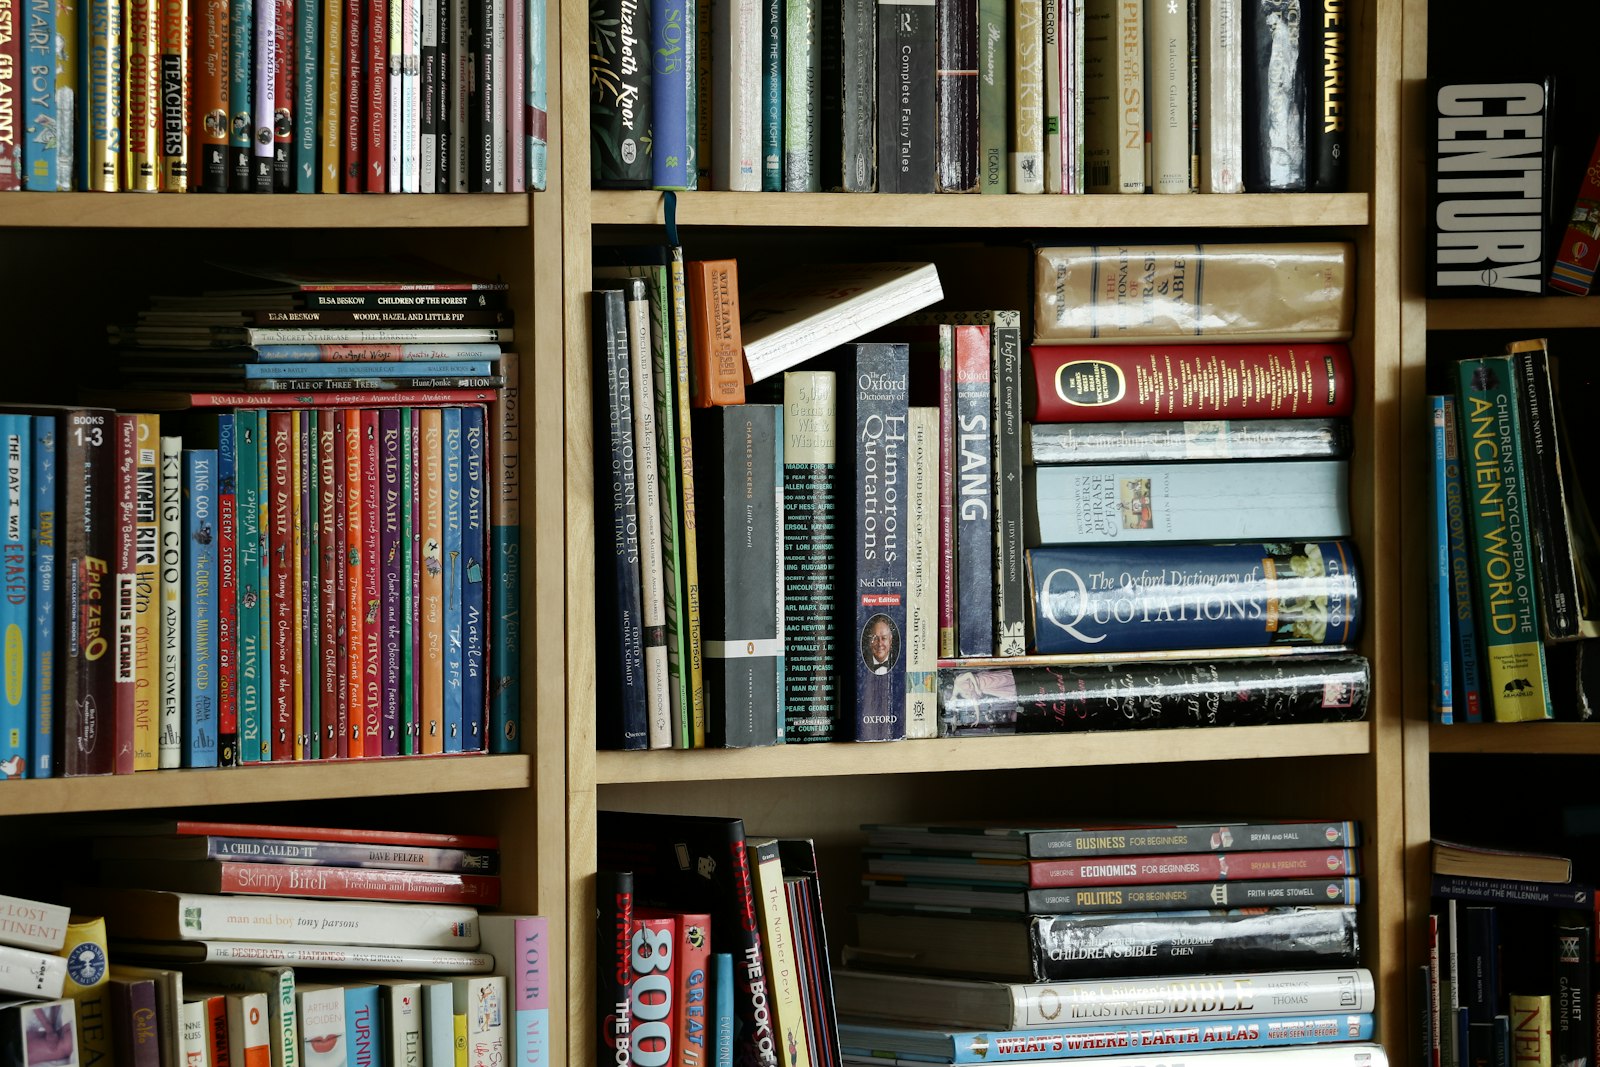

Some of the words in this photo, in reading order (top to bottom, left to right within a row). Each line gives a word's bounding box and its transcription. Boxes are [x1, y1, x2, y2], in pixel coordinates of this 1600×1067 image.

[231, 2, 245, 22] Tiny
[231, 26, 244, 48] Tapir
[769, 27, 778, 37] OF
[769, 40, 778, 59] THE
[234, 52, 244, 82] Trouble
[901, 45, 912, 106] Complete
[1169, 38, 1177, 80] Malcolm
[32, 66, 50, 108] BOY
[769, 63, 778, 98] WARRIOR
[1324, 31, 1345, 133] MARLER
[616, 82, 639, 130] Knox
[769, 103, 778, 118] OF
[900, 108, 912, 138] Fairy
[1169, 85, 1177, 128] Gladwell
[769, 122, 778, 148] LIGHT
[901, 140, 912, 173] Tales
[988, 148, 998, 186] PICADOR
[1436, 83, 1544, 293] CENTURY
[268, 313, 287, 321] ELSA
[289, 313, 320, 321] BESKOW
[352, 313, 382, 323] WOODY,
[383, 313, 406, 321] HAZEL
[407, 313, 423, 321] AND
[424, 313, 450, 321] LITTLE
[452, 313, 465, 321] PIP
[318, 297, 335, 305] ELSA
[336, 297, 365, 305] BESKOW
[377, 297, 414, 305] CHILDREN
[415, 297, 425, 305] OF
[425, 297, 440, 305] THE
[441, 297, 468, 305] FOREST
[711, 270, 722, 340] SHAKESPEARE
[718, 269, 732, 340] WILLIAM
[616, 327, 628, 359] THE
[270, 379, 287, 389] THE
[289, 379, 312, 389] TALE
[313, 379, 324, 389] OF
[326, 379, 352, 389] THREE
[354, 379, 379, 390] TREES
[412, 378, 451, 388] Hunt/Jonke
[469, 378, 490, 387] LION
[858, 374, 906, 390] Oxford
[1523, 353, 1533, 381] THREE
[618, 363, 631, 417] GREAT
[859, 391, 897, 401] Dictionary
[897, 391, 905, 401] of
[1527, 383, 1539, 418] GOTHIC
[73, 416, 104, 425] BOOKS
[503, 387, 518, 442] Roald
[8, 435, 19, 461] THE
[74, 428, 103, 447] 1-3
[1494, 394, 1514, 473] CHILDREN'S
[1531, 419, 1543, 455] NOVELS
[276, 431, 288, 484] ROALD
[447, 428, 460, 481] ROALD
[467, 426, 481, 480] ROALD
[621, 430, 635, 505] MODERN
[959, 414, 987, 521] SLANG
[1467, 396, 1506, 518] ANCIENT
[8, 467, 19, 492] DAY
[162, 451, 179, 522] KING
[502, 454, 518, 504] Dahl
[861, 413, 882, 560] Quotations
[884, 414, 904, 562] Humorous
[277, 491, 288, 535] DAHL
[448, 488, 460, 532] DAHL
[468, 486, 481, 530] DAHL
[746, 504, 754, 524] Little
[1082, 476, 1092, 534] MODERN
[1093, 474, 1103, 533] PHRASE
[1446, 481, 1466, 553] GROOVY
[9, 515, 20, 540] WAS
[38, 511, 53, 546] DAVE
[625, 513, 639, 565] POETS
[1007, 520, 1015, 539] JUDY
[1504, 476, 1525, 581] ENCYCLOPEDIA
[3, 544, 27, 605] ERASED
[40, 555, 53, 591] Pigeon
[162, 531, 179, 583] COO
[1008, 540, 1016, 582] PARKINSON
[83, 555, 107, 600] EPIC
[274, 573, 287, 601] Danny
[859, 578, 876, 587] Ned
[877, 578, 901, 587] Sherrin
[1089, 572, 1115, 590] The
[1119, 571, 1166, 593] Oxford
[1170, 566, 1241, 591] Dictionary
[1243, 565, 1259, 589] of
[1453, 556, 1470, 620] GREEKS
[1484, 523, 1516, 634] WORLD
[1517, 585, 1528, 603] OF
[120, 579, 132, 620] LOUIS
[278, 604, 288, 617] the
[688, 583, 699, 614] Ruth
[1043, 567, 1262, 643] QUOTATIONS
[164, 606, 177, 649] ADAM
[622, 609, 631, 645] MICHAEL
[1519, 607, 1532, 632] THE
[120, 624, 132, 678] SACHAR
[277, 621, 288, 665] Champion
[449, 625, 461, 655] The
[467, 605, 481, 678] Matilda
[690, 617, 702, 670] Thomson
[164, 655, 178, 716] STOWER
[278, 677, 288, 693] the
[449, 661, 460, 689] BFG
[624, 648, 633, 687] SCHMIDT
[278, 696, 288, 723] World
[862, 714, 897, 724] OXFORD
[222, 844, 229, 853] A
[230, 844, 260, 855] CHILD
[262, 845, 299, 857] CALLED
[369, 851, 390, 861] DAVE
[392, 852, 424, 863] PELZER
[1047, 840, 1072, 848] USBORNE
[1076, 836, 1125, 849] BUSINESS
[1129, 836, 1145, 846] FOR
[1146, 835, 1188, 847] BEGINNERS
[238, 868, 282, 892] Skinny
[289, 873, 327, 891] Bitch
[1049, 868, 1074, 877] USBORNE
[1080, 864, 1137, 878] ECONOMICS
[1141, 864, 1157, 874] FOR
[1158, 862, 1200, 874] BEGINNERS
[769, 885, 778, 911] The
[1045, 896, 1070, 905] USBORNE
[1076, 891, 1123, 905] POLITICS
[1128, 892, 1145, 903] FOR
[1145, 890, 1187, 902] BEGINNERS
[1440, 885, 1451, 894] the
[1452, 886, 1466, 895] little
[1467, 887, 1482, 896] book
[1483, 888, 1491, 896] of
[1491, 889, 1505, 898] THE
[1506, 890, 1549, 902] MILLENNIUM
[774, 916, 786, 964] Number
[525, 932, 540, 1000] YOUR
[745, 943, 762, 980] THE
[779, 969, 792, 1005] Devil
[1559, 977, 1569, 1032] GARDINER
[1569, 988, 1581, 1021] JULIET
[305, 1014, 342, 1026] GOLDEN
[307, 1002, 339, 1013] ARTHUR
[686, 968, 705, 1048] GREAT
[749, 982, 770, 1034] BOOK
[758, 1031, 774, 1061] OF
